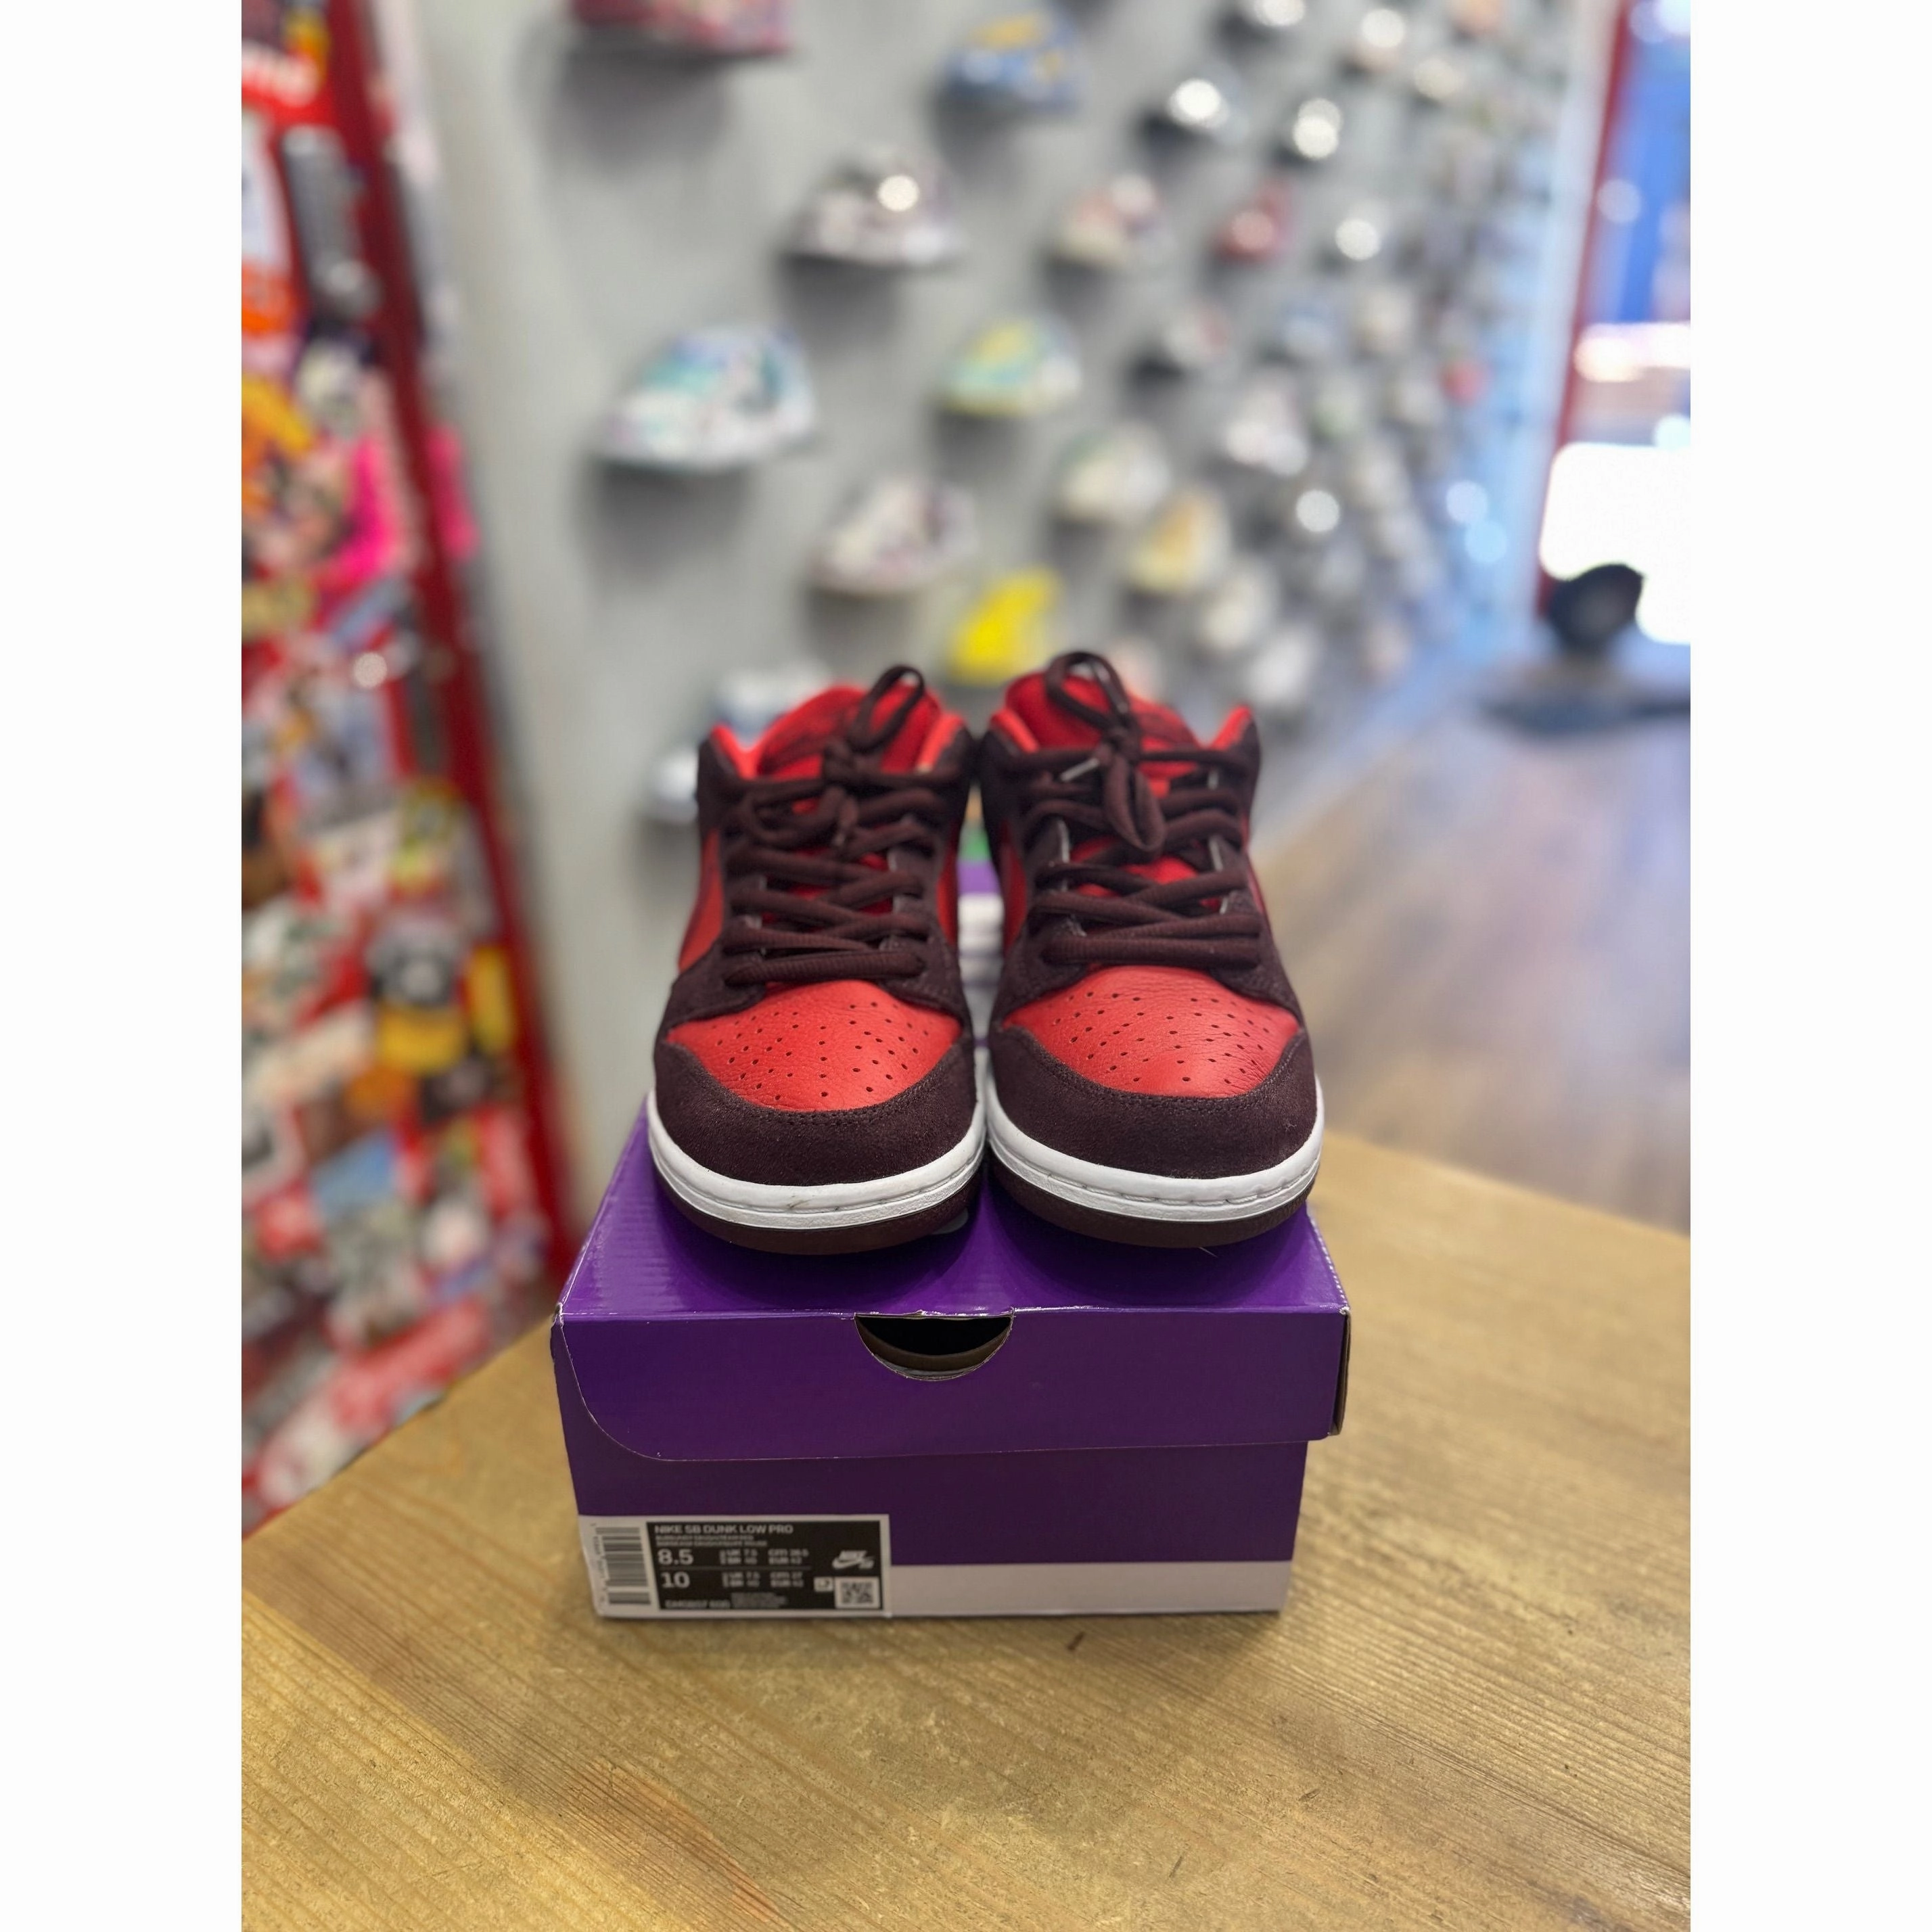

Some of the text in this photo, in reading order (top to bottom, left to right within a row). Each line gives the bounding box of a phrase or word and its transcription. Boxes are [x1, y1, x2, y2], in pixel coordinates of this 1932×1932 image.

[655, 1524, 794, 1534] NIKE SB DUNK LOW PRO
[658, 1548, 694, 1565] 8.5
[660, 1571, 690, 1588] 10
